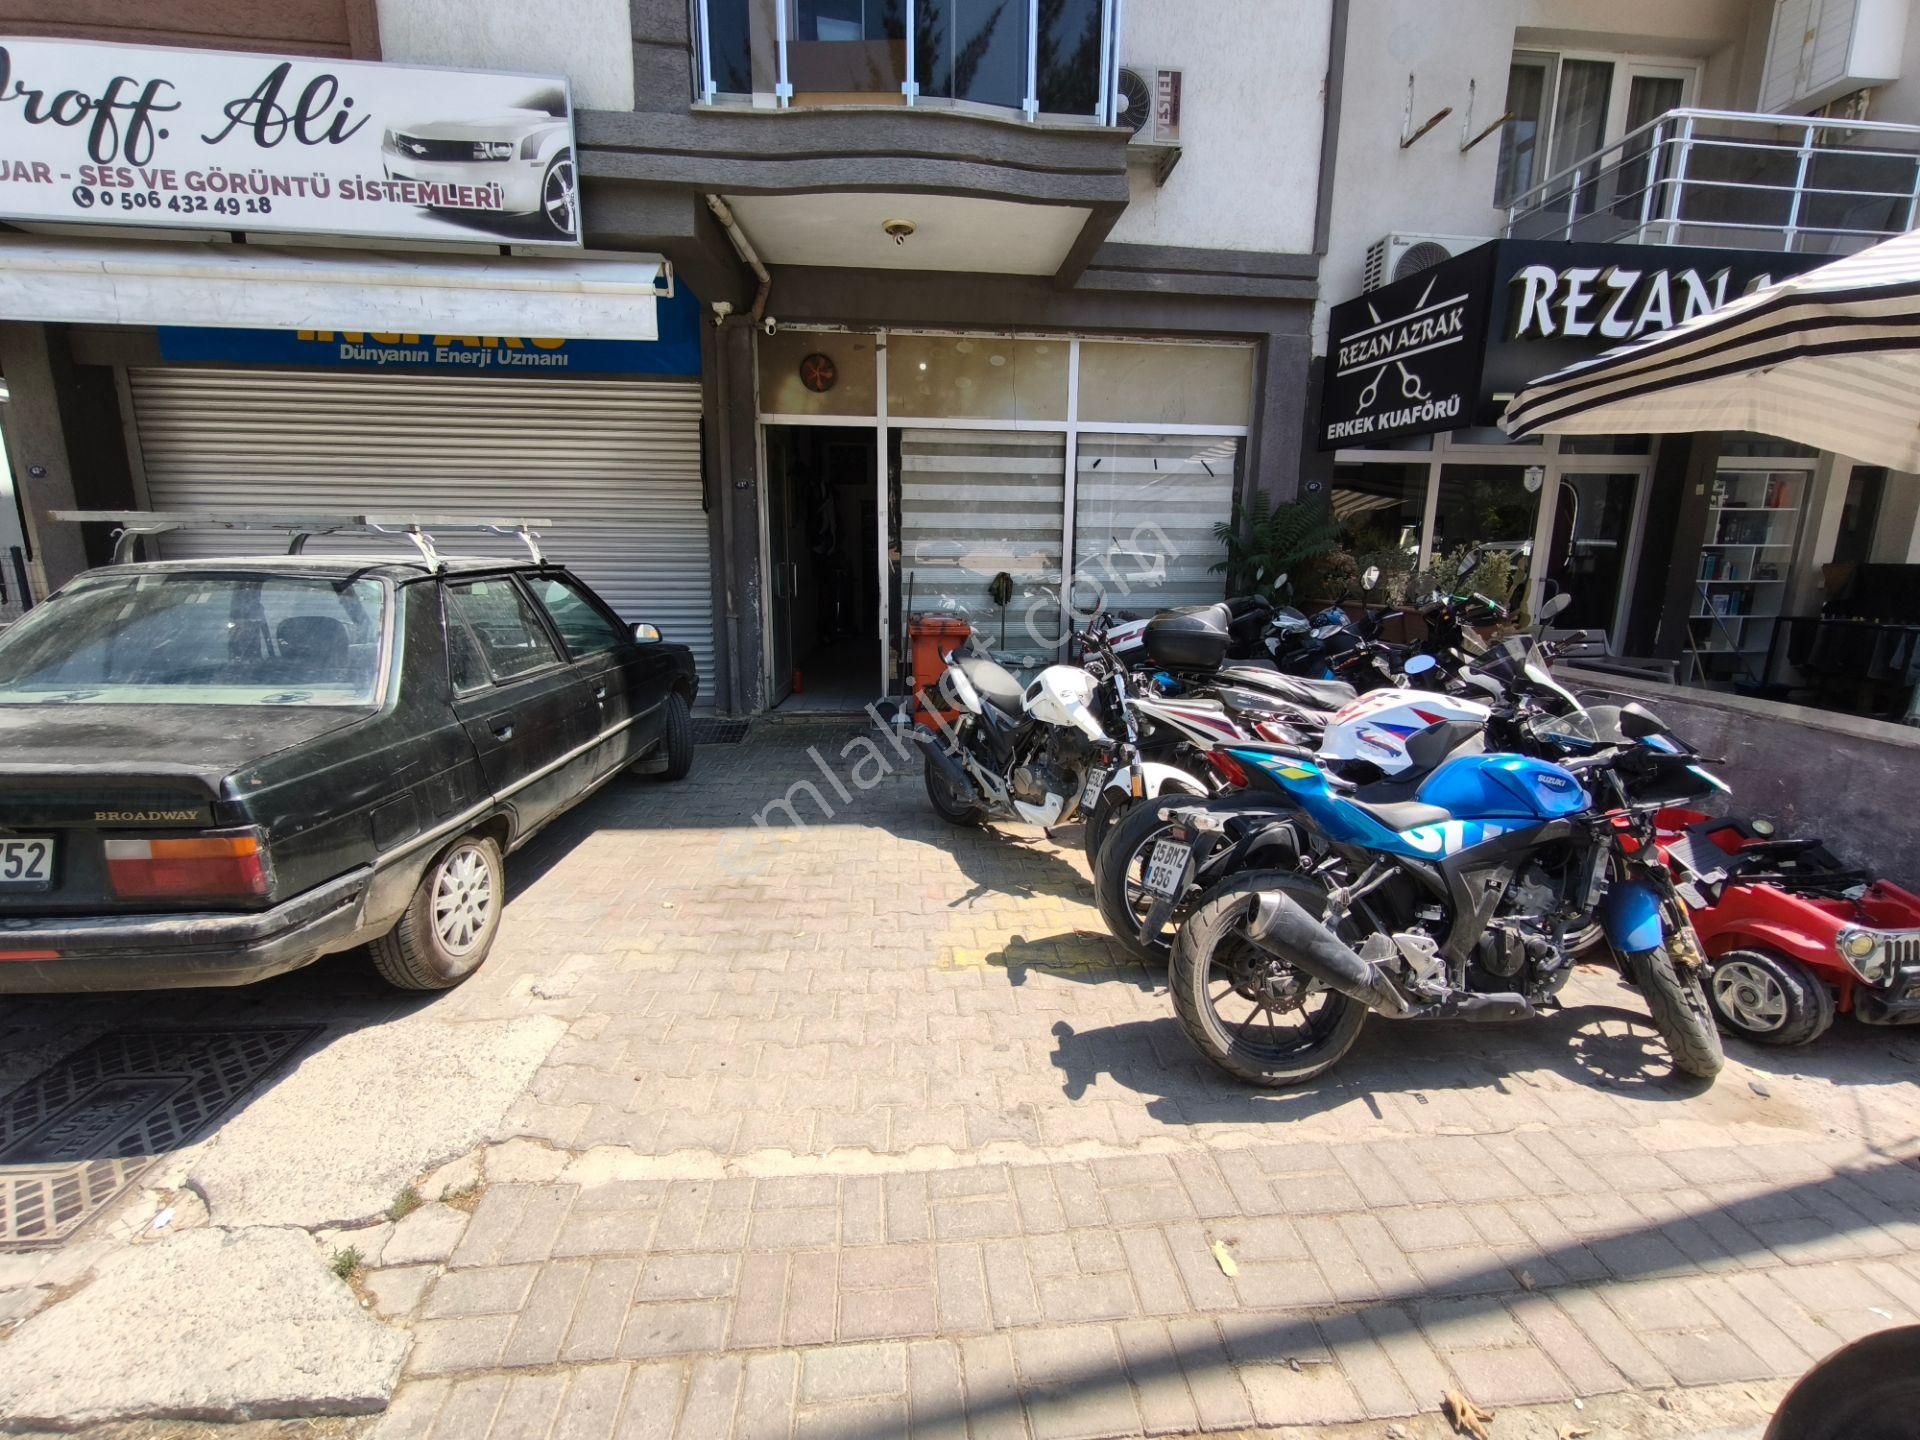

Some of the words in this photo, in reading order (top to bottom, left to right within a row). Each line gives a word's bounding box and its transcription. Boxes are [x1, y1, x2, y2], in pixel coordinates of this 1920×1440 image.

[201, 62, 371, 148] Ali
[1158, 71, 1171, 136] VESTEL
[79, 165, 134, 189] SES
[139, 168, 178, 191] VE
[185, 166, 331, 199] GÖRÜNTÜ
[339, 174, 502, 209] SİSTEMLERİ
[101, 191, 114, 206] 0
[121, 190, 161, 210] 506
[168, 195, 208, 213] 432
[214, 197, 241, 215] 49
[246, 196, 272, 214] 18
[1512, 265, 1731, 339] REZAN
[340, 344, 429, 365] Dünyanın
[436, 347, 491, 368] Enerji
[497, 350, 568, 366] Uzmanı
[1338, 329, 1394, 369] REZAN
[1396, 307, 1464, 351] AZRAK
[1327, 415, 1375, 440] ERKEK
[1378, 394, 1460, 430] KUAFÖRÜ
[1537, 774, 1567, 787] SUZUKI
[94, 811, 199, 821] BROADWAY
[0, 842, 46, 879] 52
